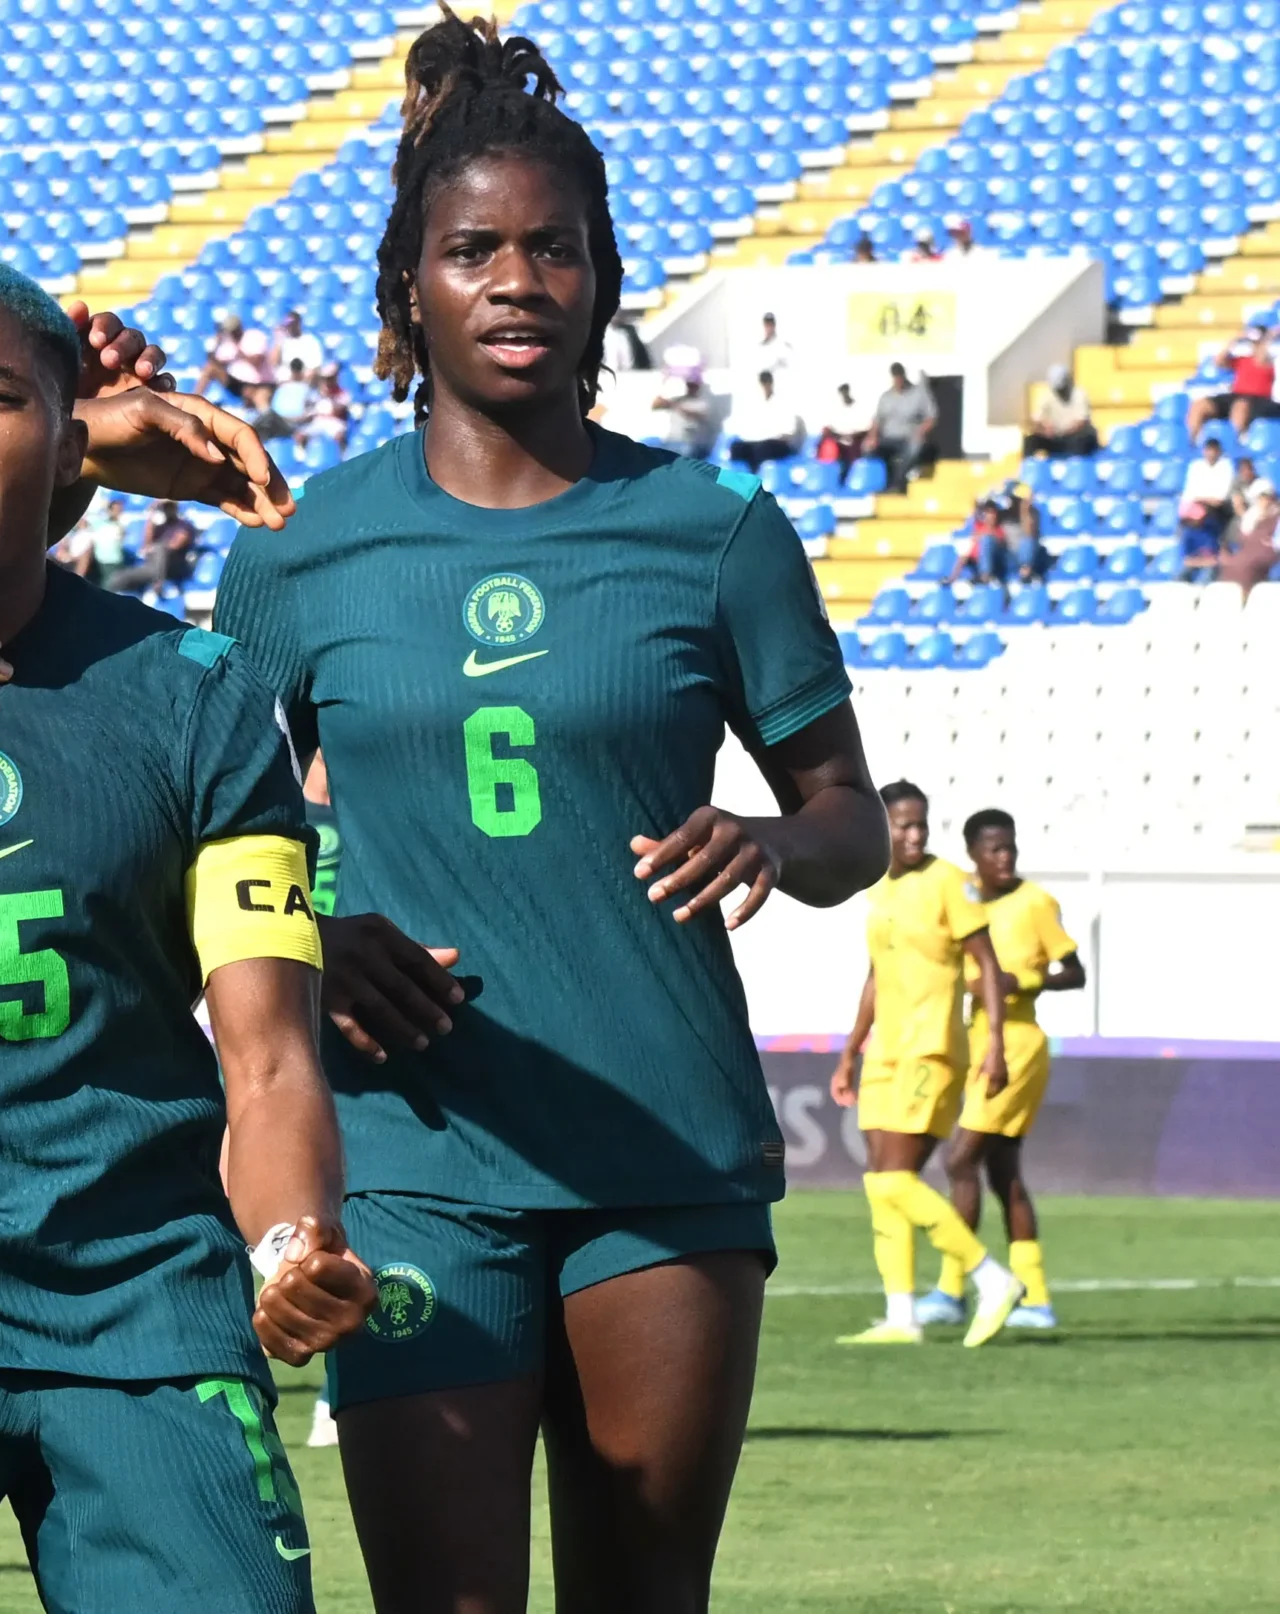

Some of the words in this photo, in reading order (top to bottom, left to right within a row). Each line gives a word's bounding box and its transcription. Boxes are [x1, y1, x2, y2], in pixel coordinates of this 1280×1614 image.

[471, 577, 518, 601] FOOTBALL
[463, 706, 542, 837] 6
[407, 1268, 433, 1322] FEDERATION
[392, 1326, 413, 1338] 1945
